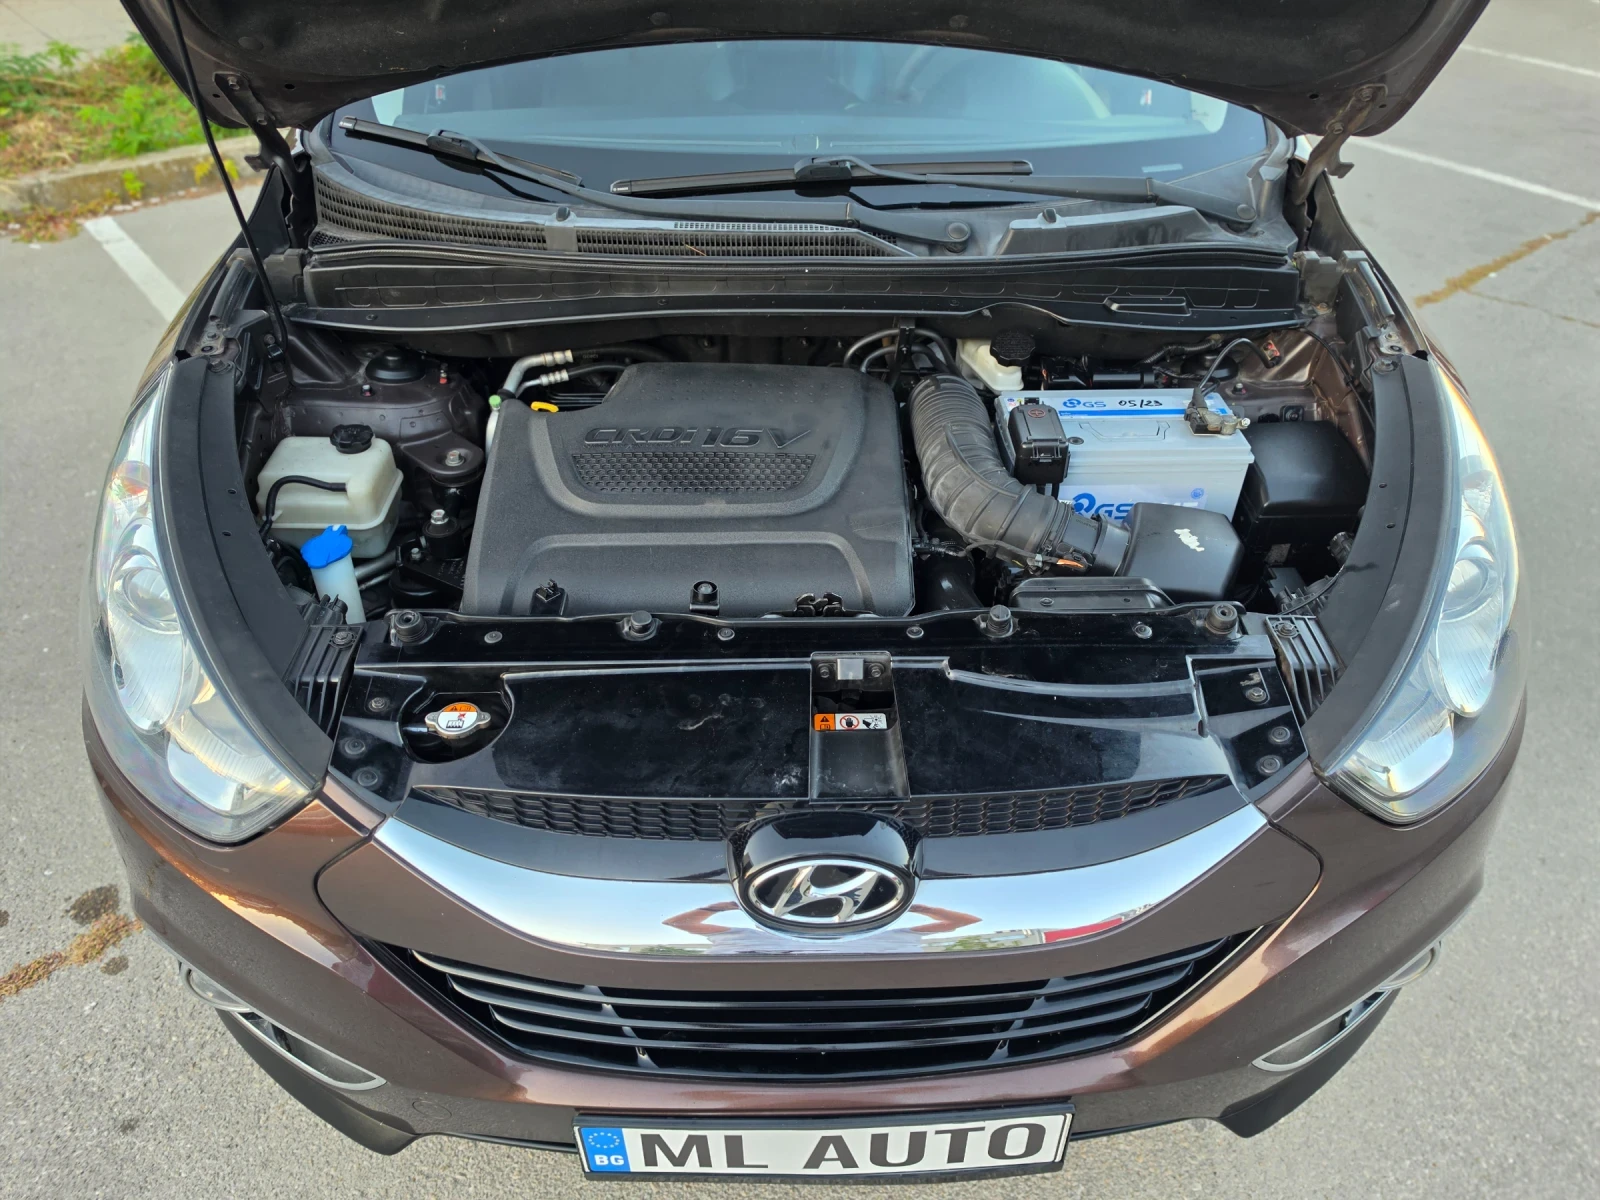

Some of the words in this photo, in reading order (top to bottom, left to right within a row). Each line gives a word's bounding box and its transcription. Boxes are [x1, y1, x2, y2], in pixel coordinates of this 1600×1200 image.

[1082, 400, 1107, 409] GS
[1094, 503, 1135, 520] GS
[640, 1132, 769, 1169] ML
[802, 1122, 1047, 1170] AUTO
[593, 1153, 625, 1167] BG
